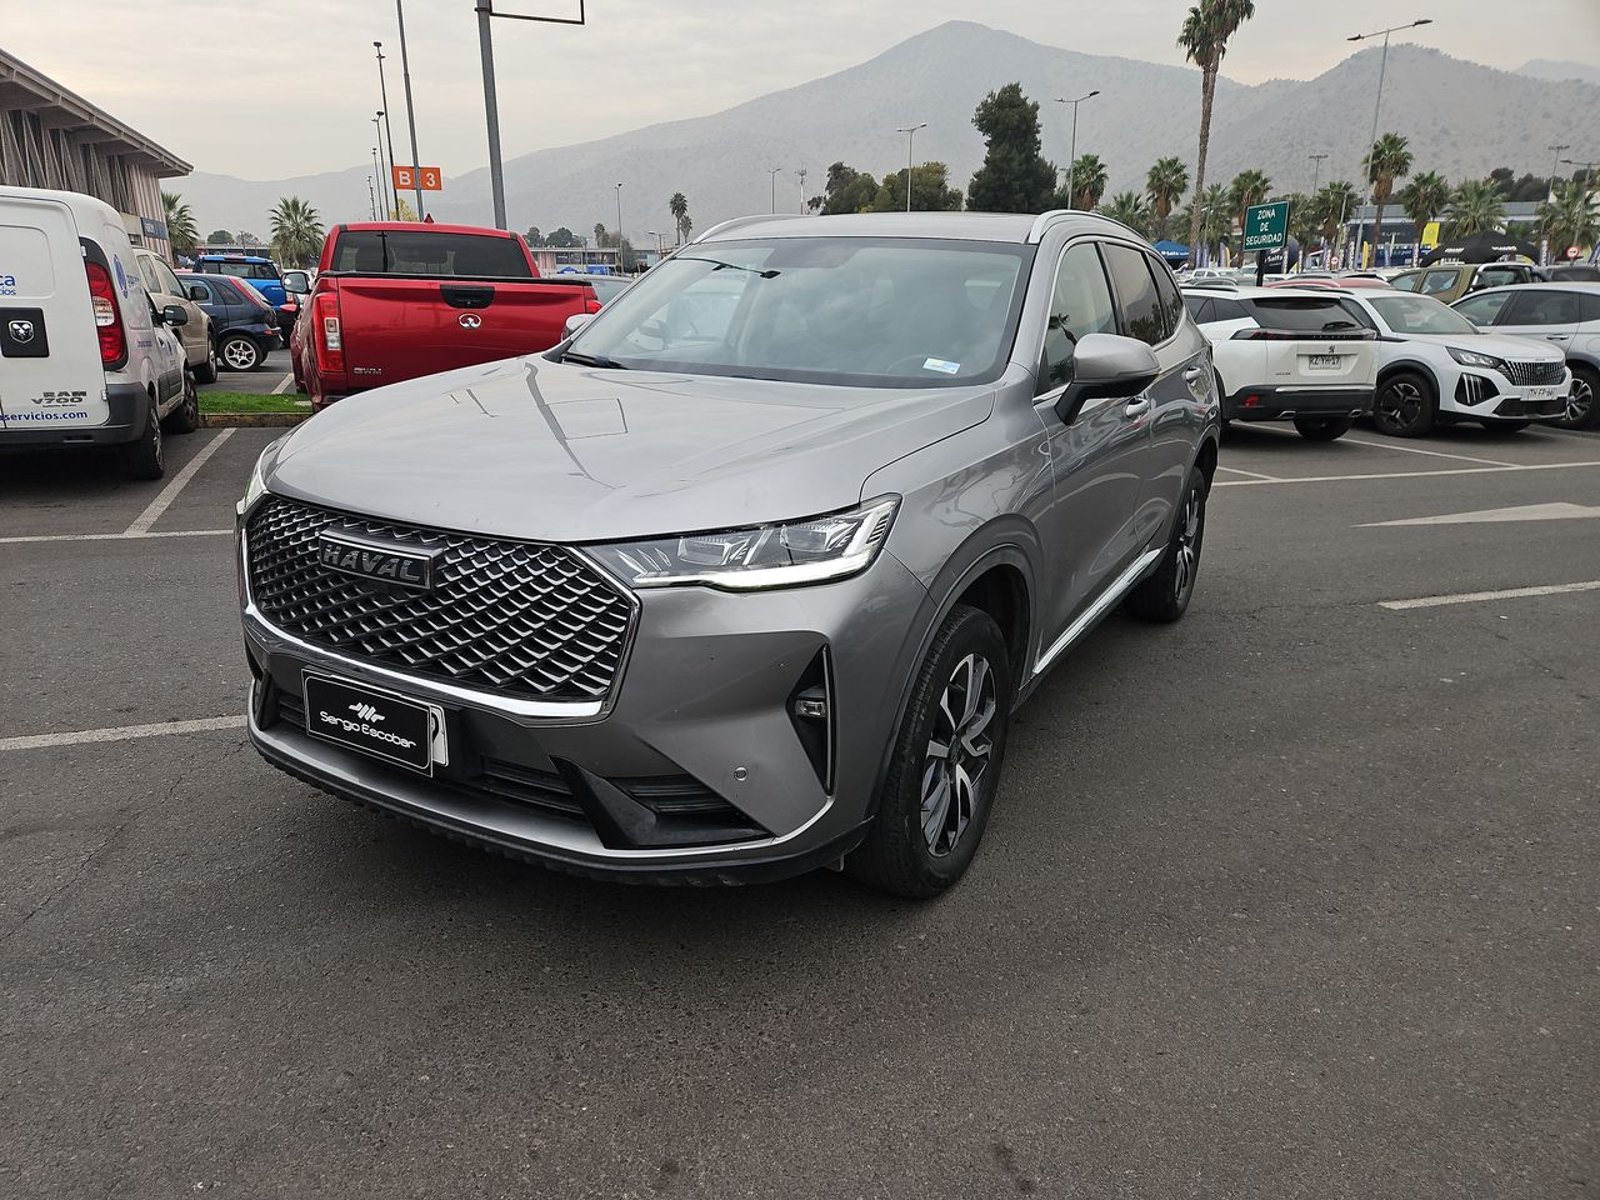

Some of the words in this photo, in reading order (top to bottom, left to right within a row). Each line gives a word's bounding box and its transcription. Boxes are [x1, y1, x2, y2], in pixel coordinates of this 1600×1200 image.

[399, 170, 411, 186] B
[426, 172, 436, 187] 3
[1257, 208, 1276, 220] ZONA
[1260, 221, 1270, 232] DE
[1245, 232, 1283, 246] SEGURIDAD
[43, 390, 87, 398] RAM
[31, 397, 83, 405] V700
[323, 544, 421, 581] HAVAL
